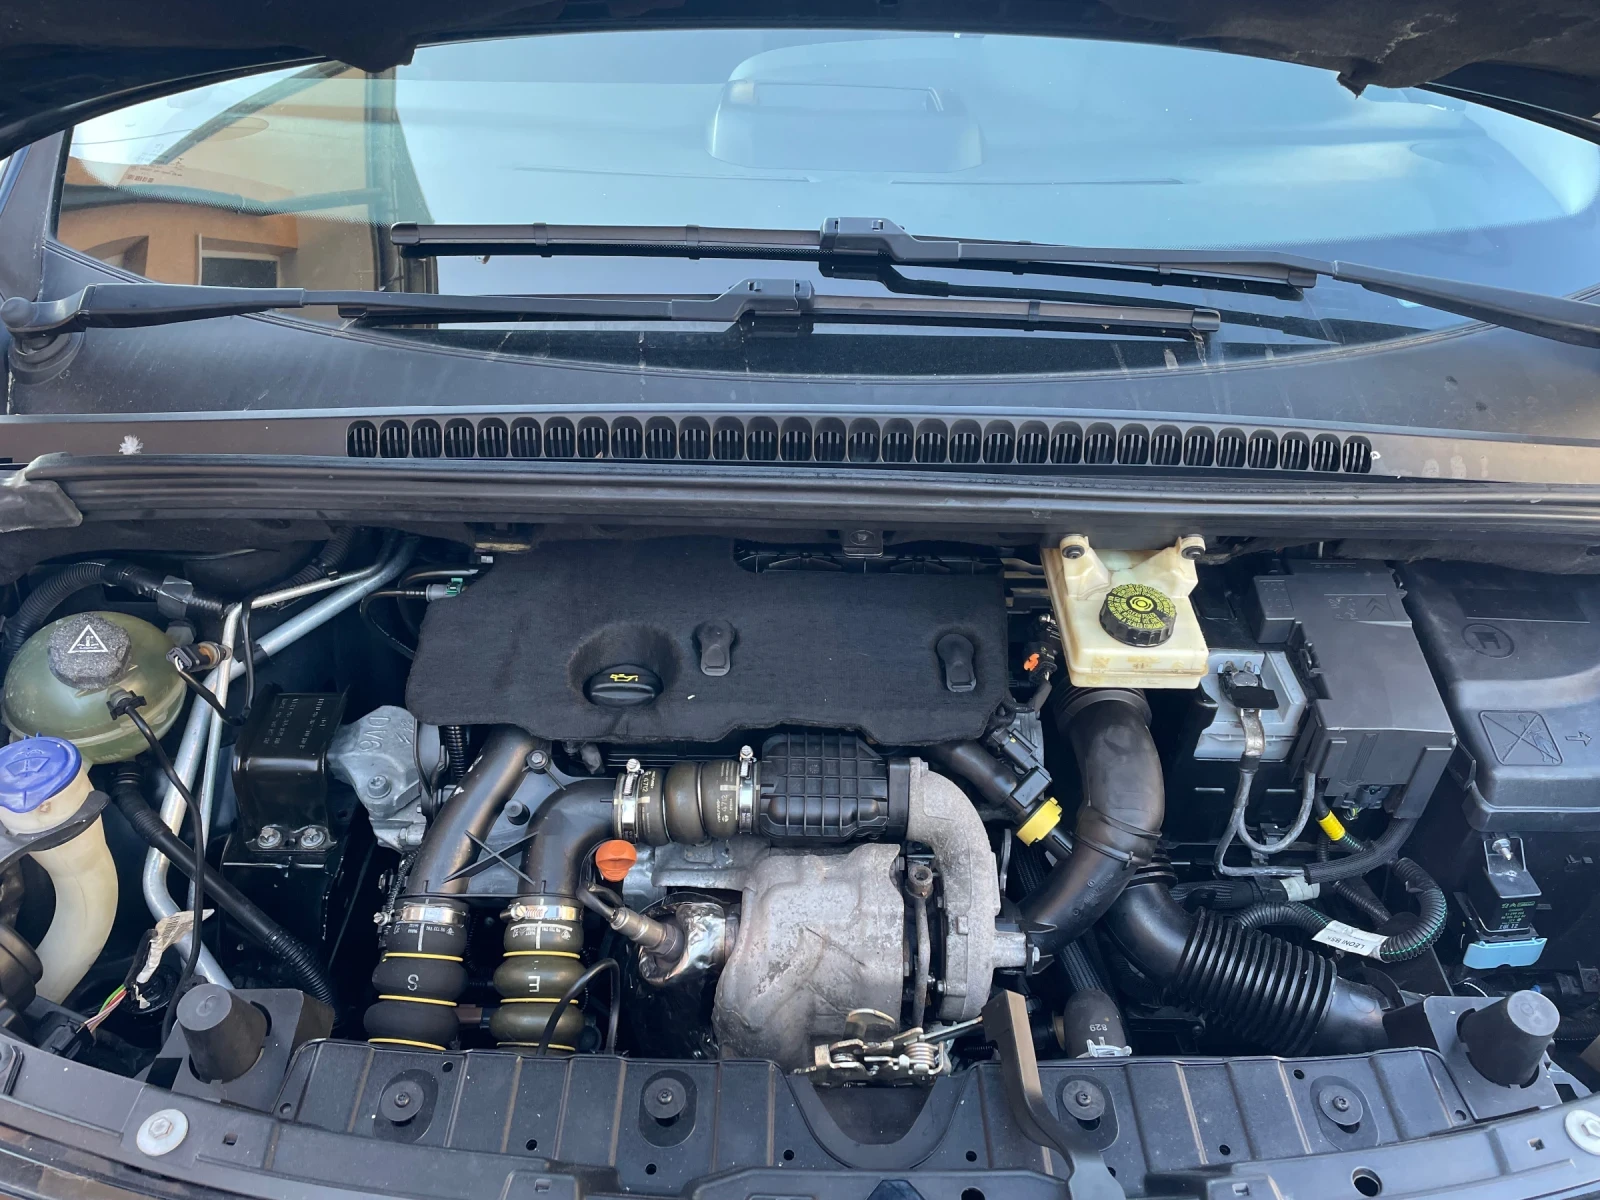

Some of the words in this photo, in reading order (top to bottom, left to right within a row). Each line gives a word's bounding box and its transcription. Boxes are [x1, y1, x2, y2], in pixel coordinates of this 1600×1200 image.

[359, 716, 391, 751] DV6
[1342, 939, 1365, 950] LEONI
[407, 973, 420, 991] S
[527, 975, 541, 993] E
[1089, 1023, 1108, 1032] 829
